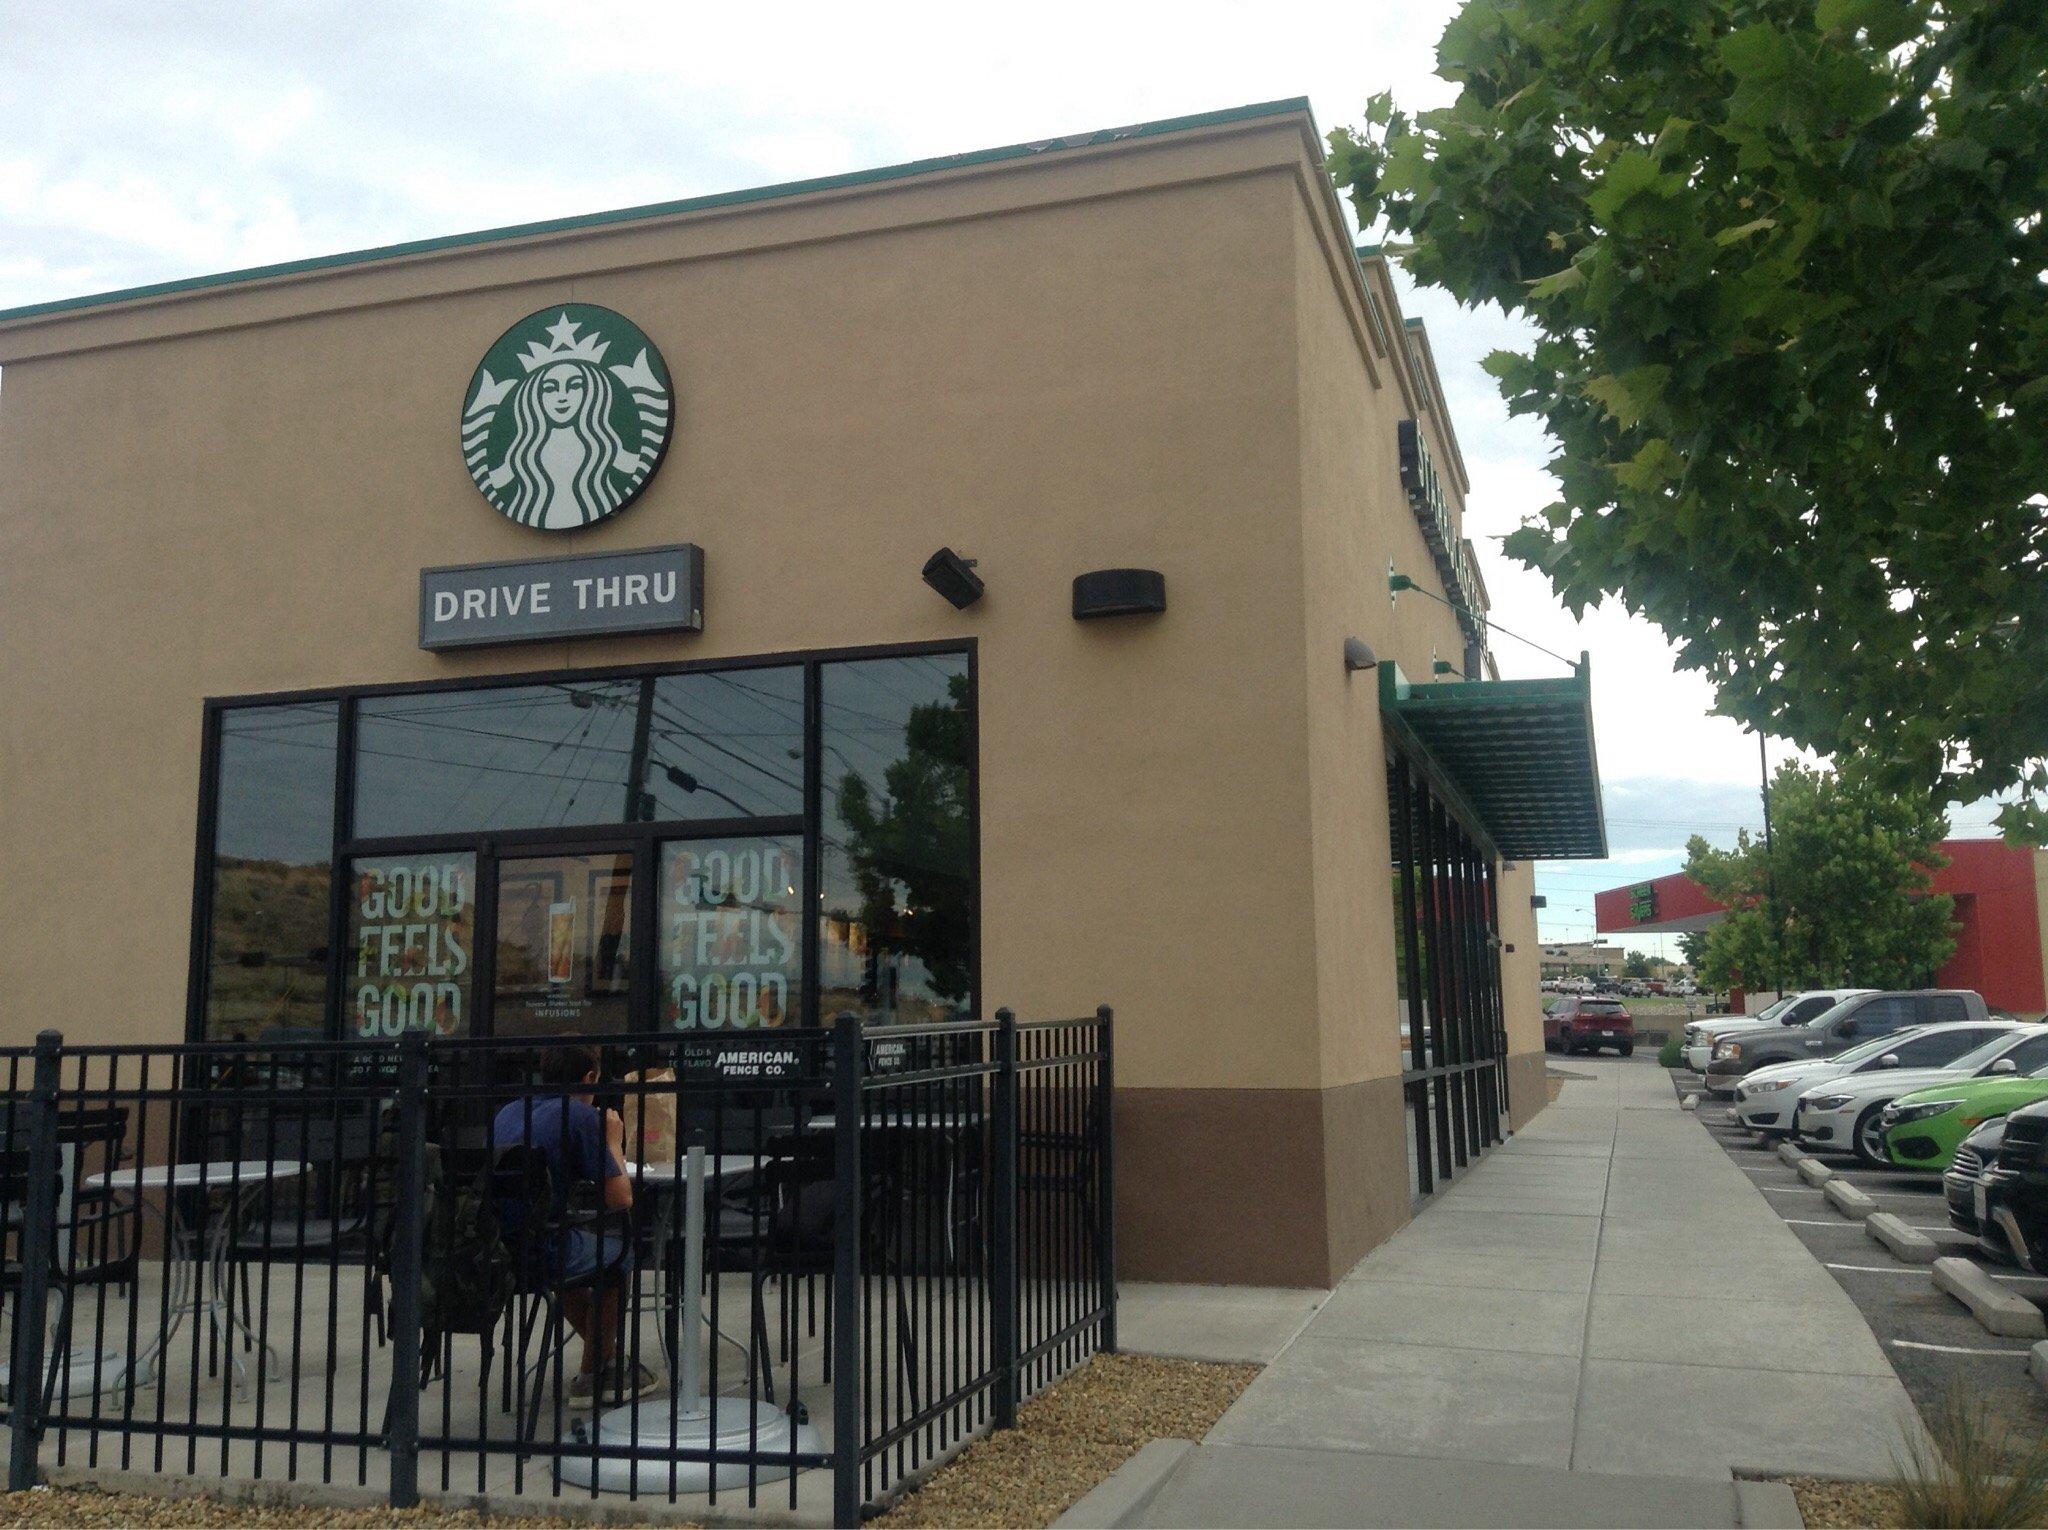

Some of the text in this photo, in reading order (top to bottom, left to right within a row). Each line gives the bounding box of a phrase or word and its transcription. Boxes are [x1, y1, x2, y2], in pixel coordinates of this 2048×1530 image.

[434, 570, 676, 622] DRIVE THRU
[359, 864, 466, 919] GOOD
[674, 848, 791, 905] GOOD
[357, 923, 467, 977] FEELS
[672, 910, 794, 967] FEELS
[356, 982, 462, 1037] GOOD
[534, 1008, 582, 1018] INFUSIONS
[672, 972, 788, 1029] GOOD
[723, 1065, 786, 1075] FENCE CO.
